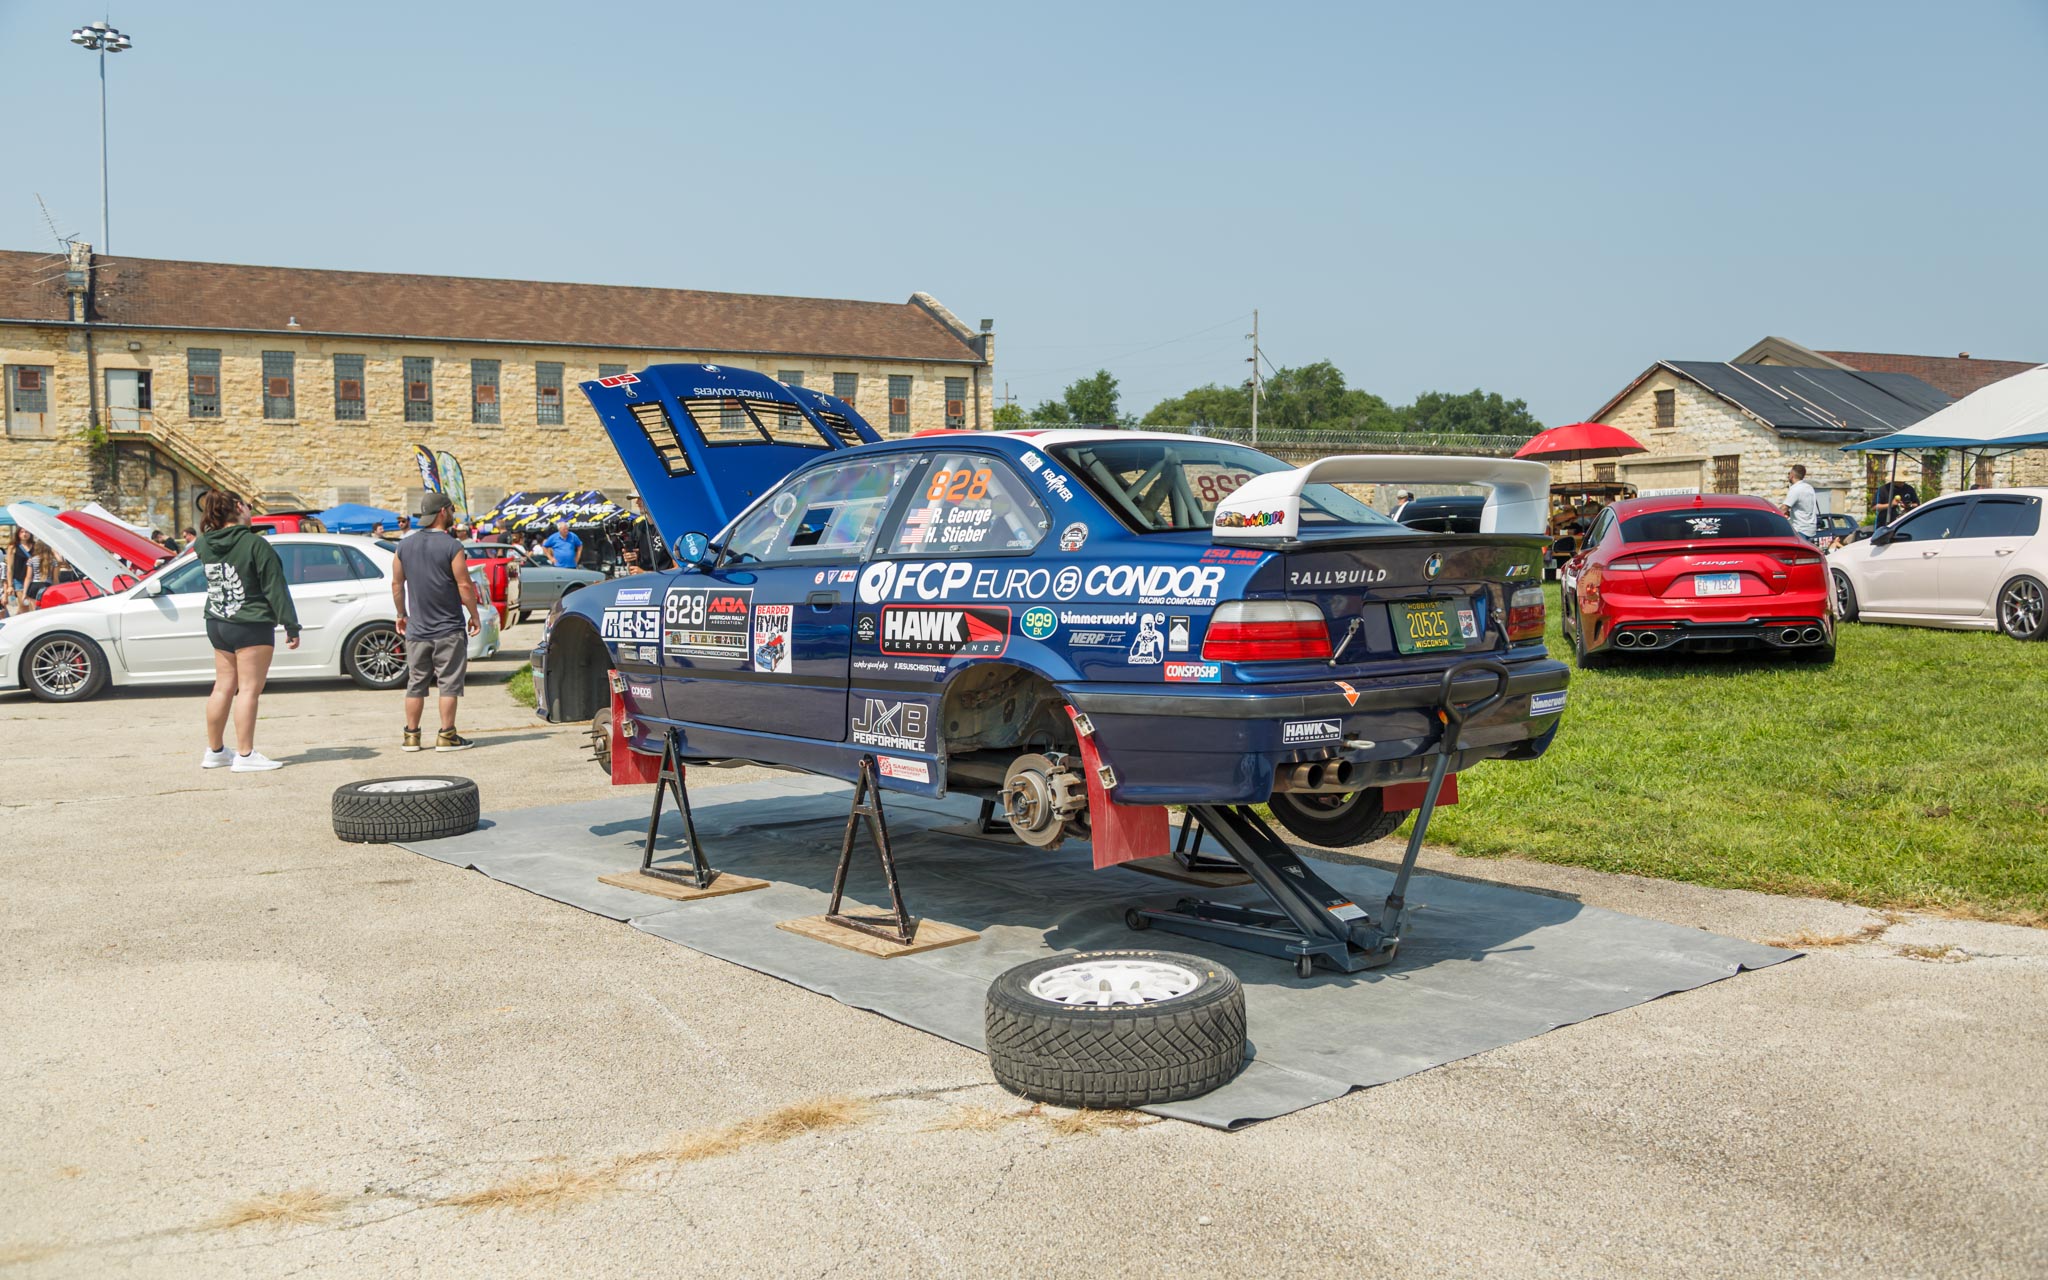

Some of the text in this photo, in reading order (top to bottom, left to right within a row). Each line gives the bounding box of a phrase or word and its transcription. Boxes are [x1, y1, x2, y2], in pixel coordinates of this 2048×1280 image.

[693, 387, 736, 396] LOUVERS
[926, 468, 993, 501] 828
[543, 503, 617, 515] GARAGE
[931, 507, 992, 526] R. George
[924, 526, 987, 543] H. Stieber
[893, 561, 1226, 600] FCP EURO CONDOR
[1290, 569, 1387, 585] RALLYBUILD
[707, 597, 748, 613] ARA
[1138, 597, 1217, 606] RACING COMPONENTS
[1408, 602, 1439, 610] HOBBYIST
[666, 594, 704, 625] 828
[757, 605, 790, 615] BEARDED
[1026, 613, 1052, 627] 909
[1060, 611, 1137, 625] bimmerworld
[1406, 611, 1449, 638] 20525
[885, 611, 964, 642] HAWK
[1033, 628, 1043, 636] EK
[1069, 632, 1105, 644] NERP
[1415, 639, 1449, 648] WISCONSIN
[885, 642, 1001, 652] PERFORMANCE
[1166, 664, 1219, 679] CONSPDSHP
[852, 698, 929, 741] JXB
[1285, 733, 1339, 741] PERFORMANCE
[1286, 722, 1323, 737] HAWK
[853, 733, 926, 752] PERFORMANCE
